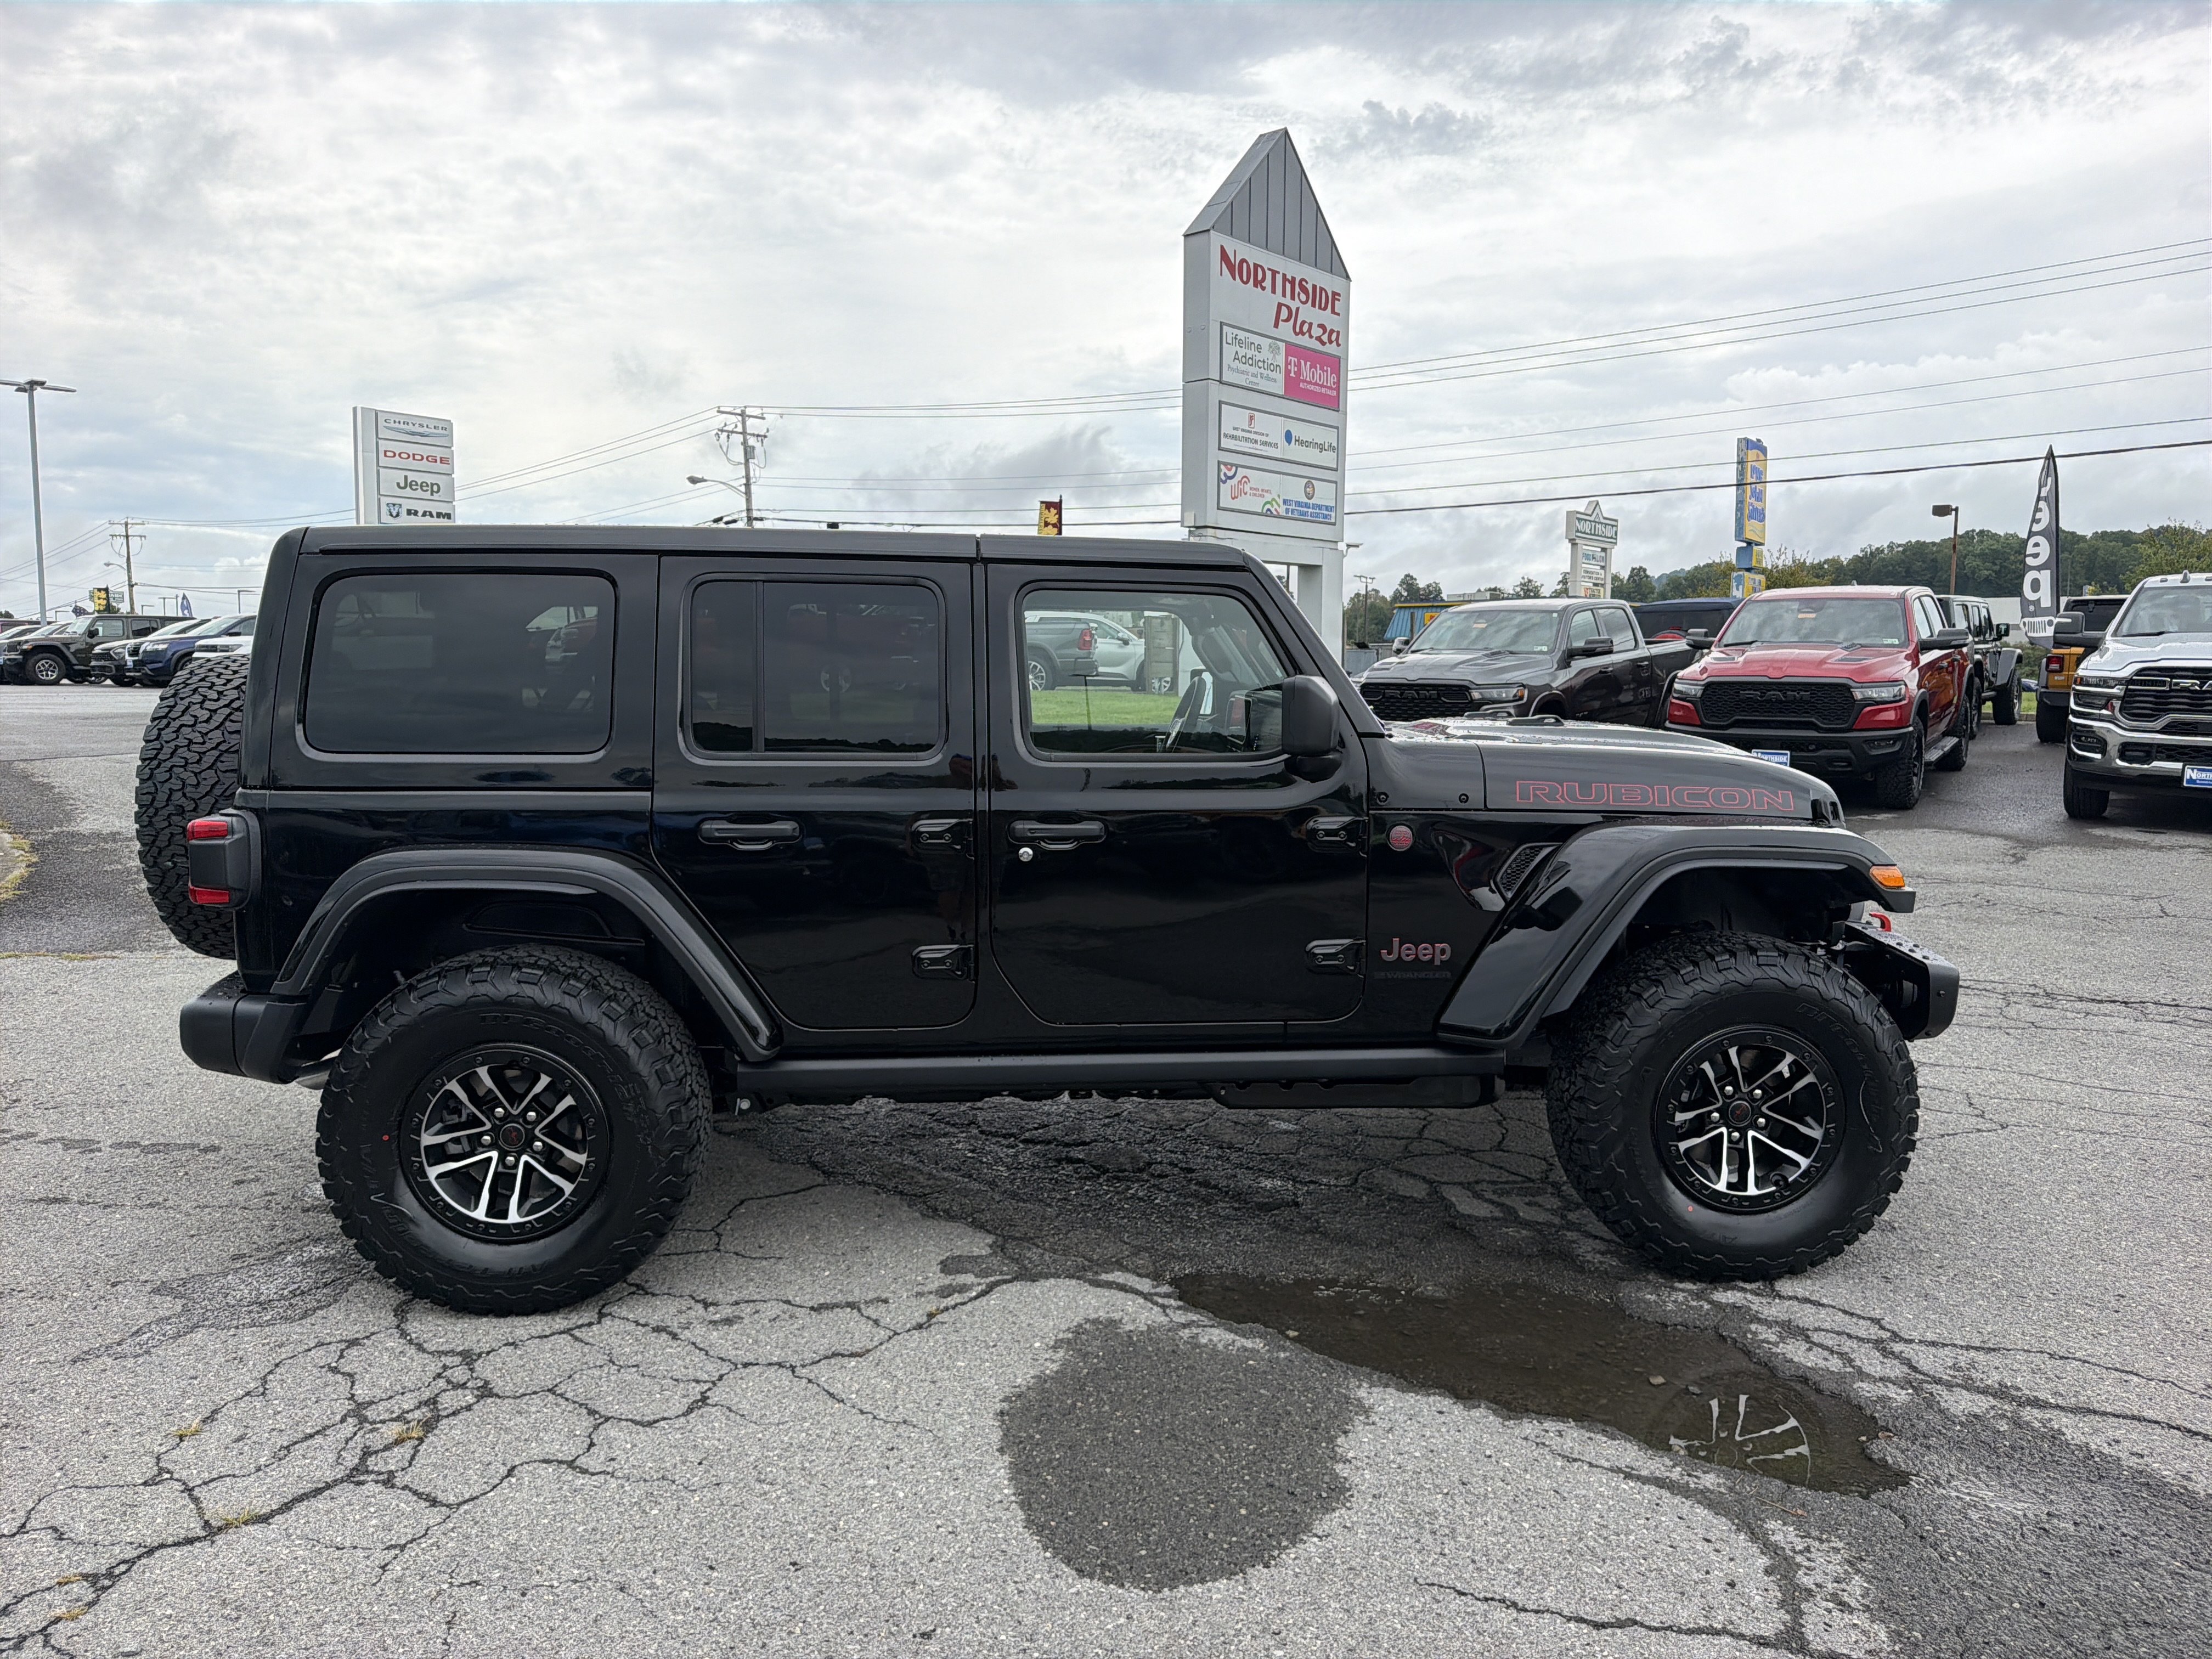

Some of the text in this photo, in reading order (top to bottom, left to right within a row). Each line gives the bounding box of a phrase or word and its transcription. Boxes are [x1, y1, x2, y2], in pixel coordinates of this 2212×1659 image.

[1220, 244, 1341, 317] NORTHSIDE
[1273, 301, 1341, 347] Plaza
[1225, 331, 1262, 353] Lifeline
[1233, 350, 1282, 374] Addiction
[1227, 364, 1250, 376] Psychiatric
[1259, 372, 1277, 383] Wellness
[1245, 377, 1260, 387] Center
[1300, 382, 1337, 396] AUTHORIZED RETAILER
[384, 419, 448, 431] CHRYSLER
[1223, 432, 1259, 445] REHABILITATION
[1259, 439, 1279, 449] SERVICES
[1294, 435, 1336, 453] HearingLife
[383, 449, 450, 465] DODGE
[396, 475, 441, 496] Jeep
[406, 508, 452, 520] RAM
[1283, 498, 1335, 513] WEST VIRGINIA DEPARTMENT
[1290, 508, 1310, 518] VETERANS
[1310, 511, 1332, 521] ASSISTANCE
[1575, 518, 1617, 538] NORTHSIDE
[1384, 690, 1437, 699] RAM
[1740, 691, 1810, 701] RAM
[1516, 780, 1795, 811] RUBICON
[1380, 938, 1452, 966] Jeep
